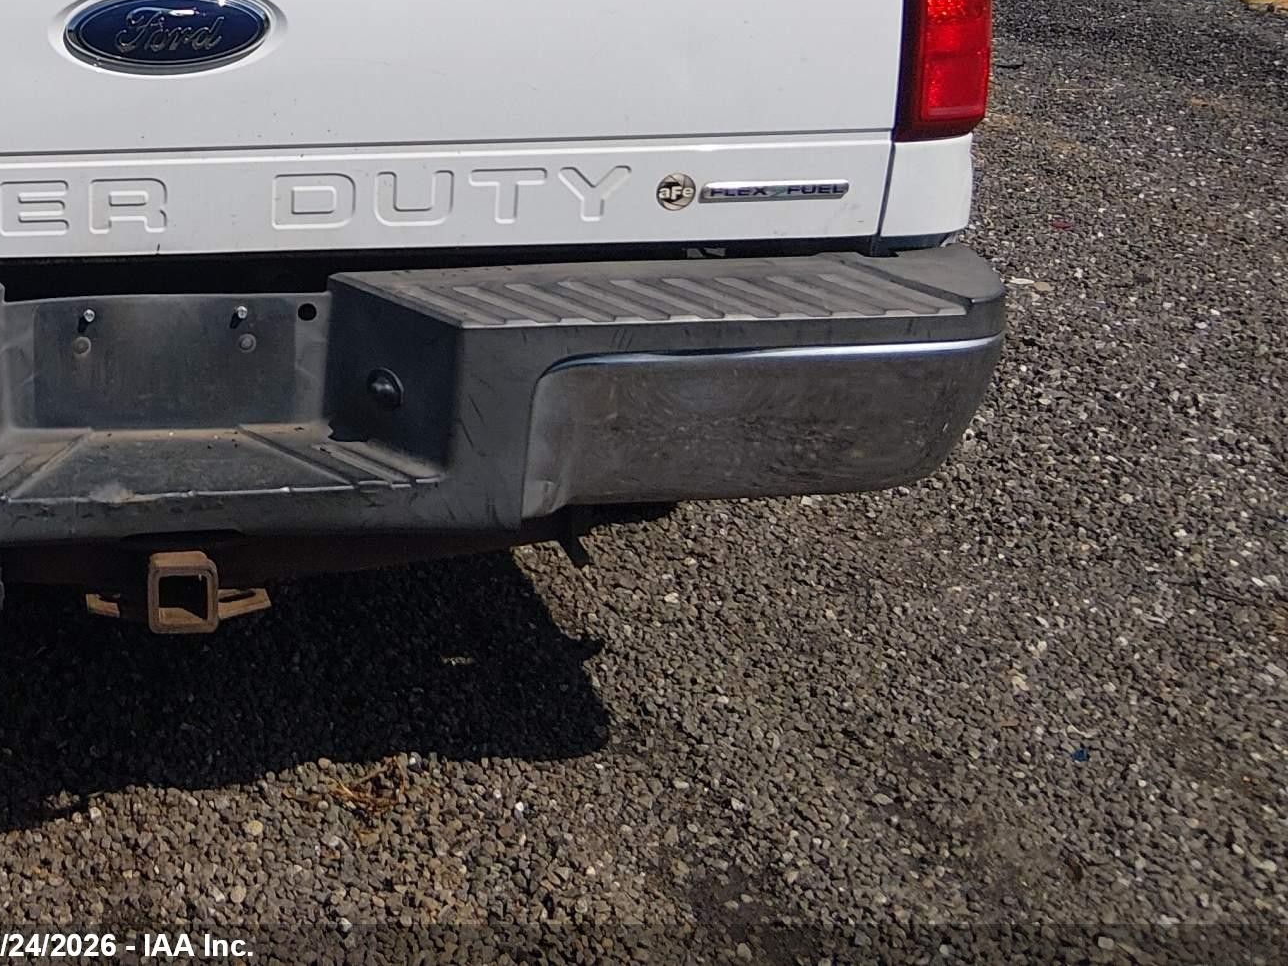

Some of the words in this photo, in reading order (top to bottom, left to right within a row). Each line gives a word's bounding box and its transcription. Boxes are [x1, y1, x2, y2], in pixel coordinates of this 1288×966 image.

[115, 6, 225, 53] Ford
[271, 164, 633, 230] DUTY
[658, 185, 694, 200] aFe
[710, 187, 767, 197] FLEX
[786, 183, 845, 195] FUEL
